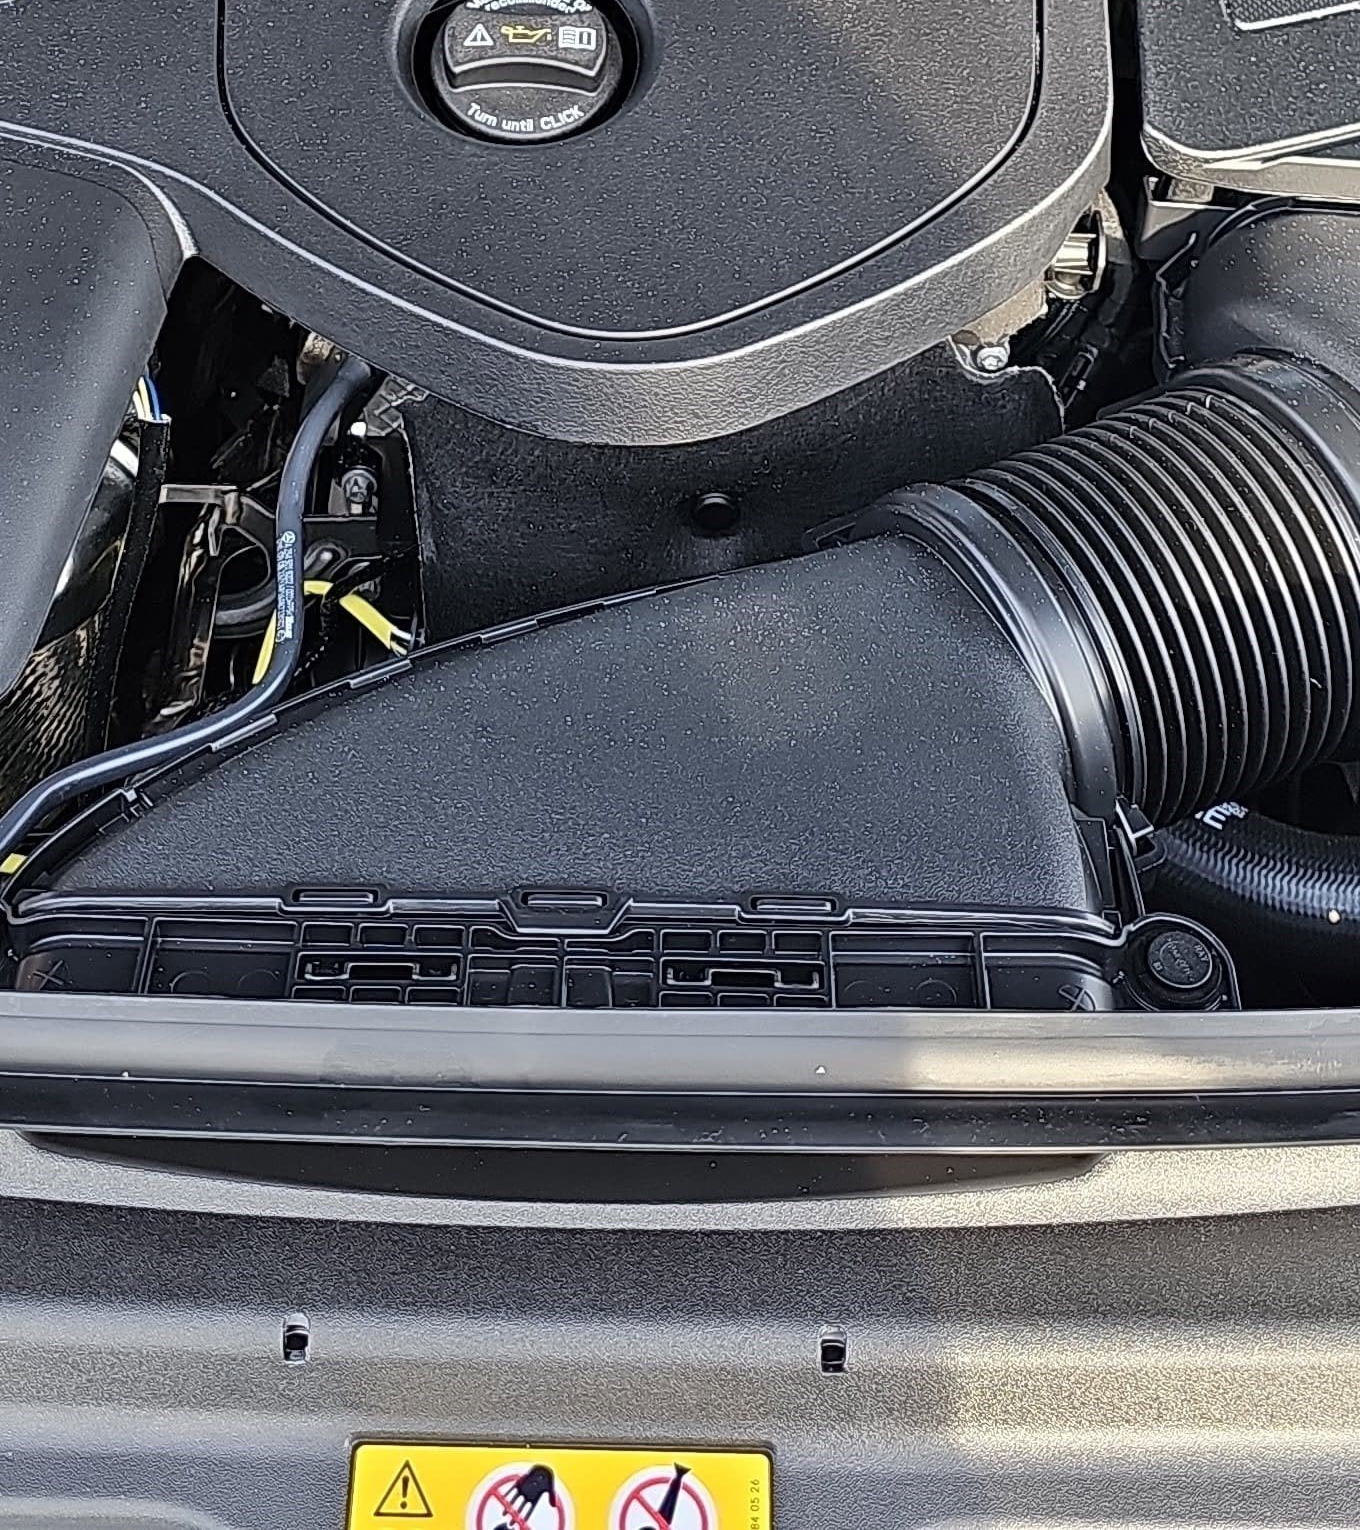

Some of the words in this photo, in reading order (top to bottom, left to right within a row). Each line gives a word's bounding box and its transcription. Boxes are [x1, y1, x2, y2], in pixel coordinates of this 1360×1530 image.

[467, 102, 498, 127] Turn
[501, 118, 534, 132] until
[540, 104, 585, 130] CLICK
[750, 1479, 761, 1494] 26
[750, 1497, 761, 1512] 05
